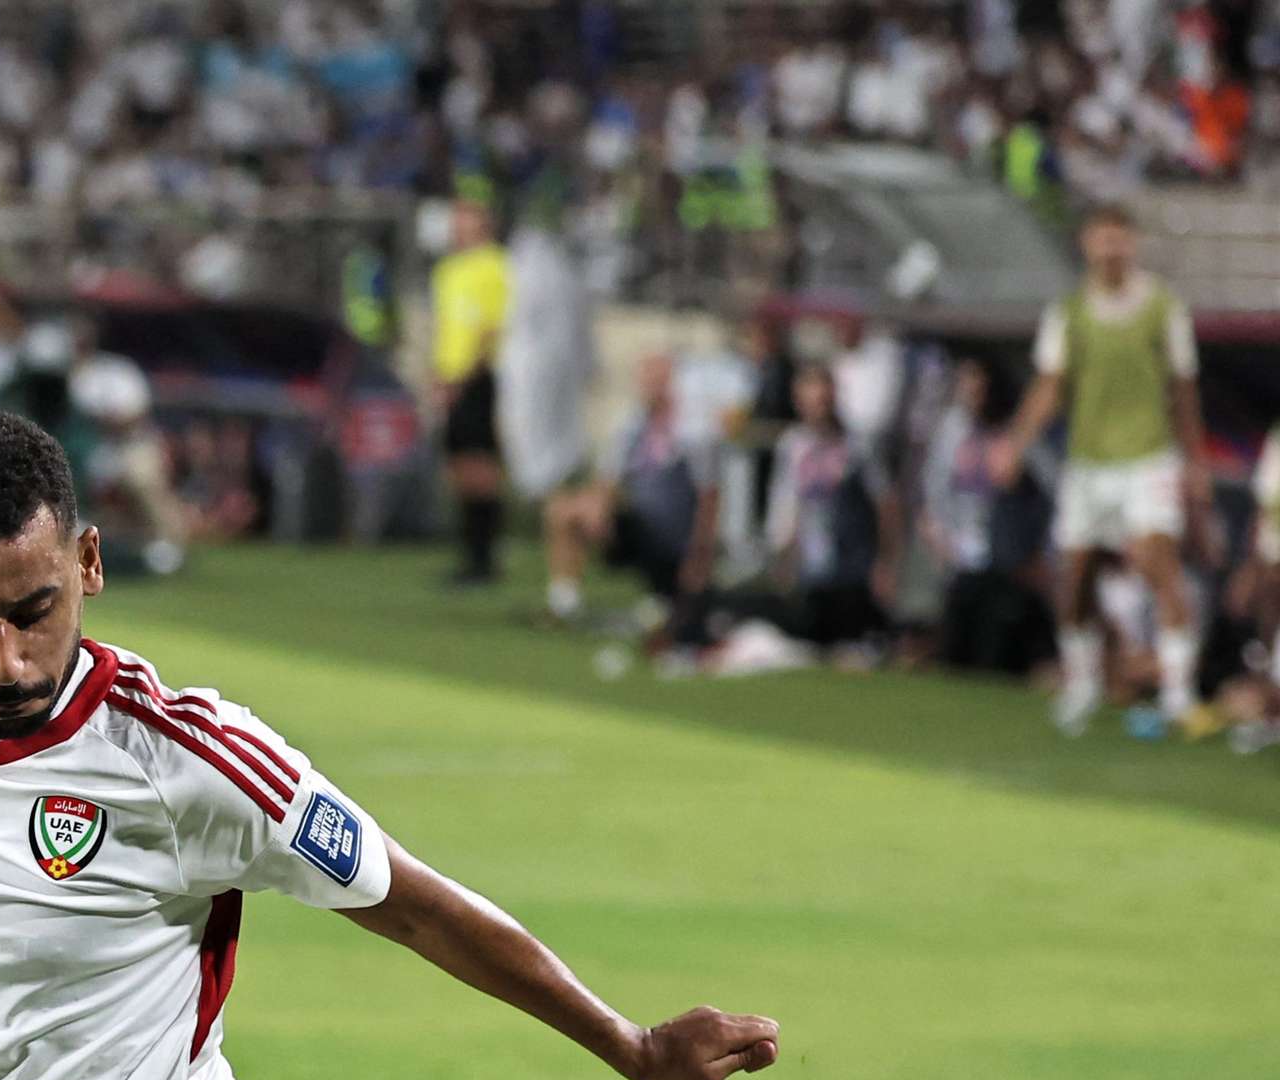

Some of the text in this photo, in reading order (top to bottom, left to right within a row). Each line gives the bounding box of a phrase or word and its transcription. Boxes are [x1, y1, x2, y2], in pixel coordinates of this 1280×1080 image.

[50, 817, 84, 834] UAE
[307, 799, 329, 843] FOOTBALL
[316, 803, 337, 851] UNITES
[55, 831, 73, 844] FA
